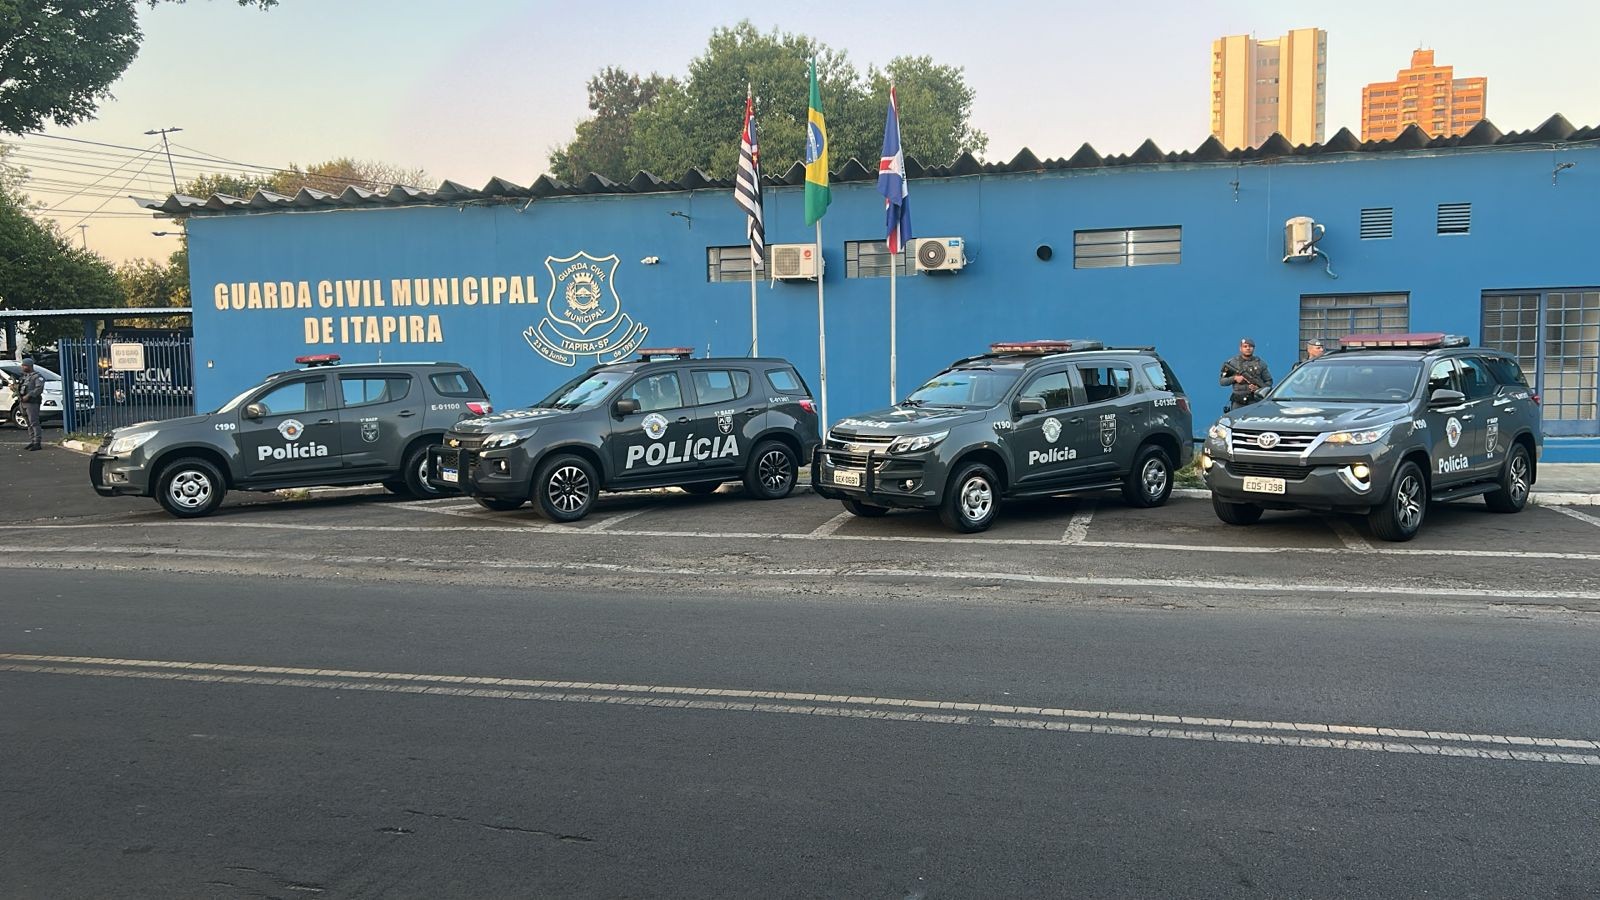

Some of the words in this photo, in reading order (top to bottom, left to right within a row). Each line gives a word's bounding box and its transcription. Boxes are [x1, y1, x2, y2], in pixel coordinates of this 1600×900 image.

[558, 262, 588, 282] GUARDA
[590, 264, 607, 282] CIVIL
[214, 281, 311, 310] GUARDA
[318, 279, 385, 308] CIVIL
[392, 276, 539, 305] MUNICIPAL
[563, 308, 606, 323] MUNICIPAL
[304, 317, 335, 344] DE
[340, 314, 443, 344] ITAPIRA
[561, 338, 609, 351] ITAPIRA-SP
[257, 441, 328, 461] Polícia
[625, 433, 739, 469] POLÍCIA
[1028, 446, 1077, 466] Polícia
[1438, 453, 1469, 474] Polícia
